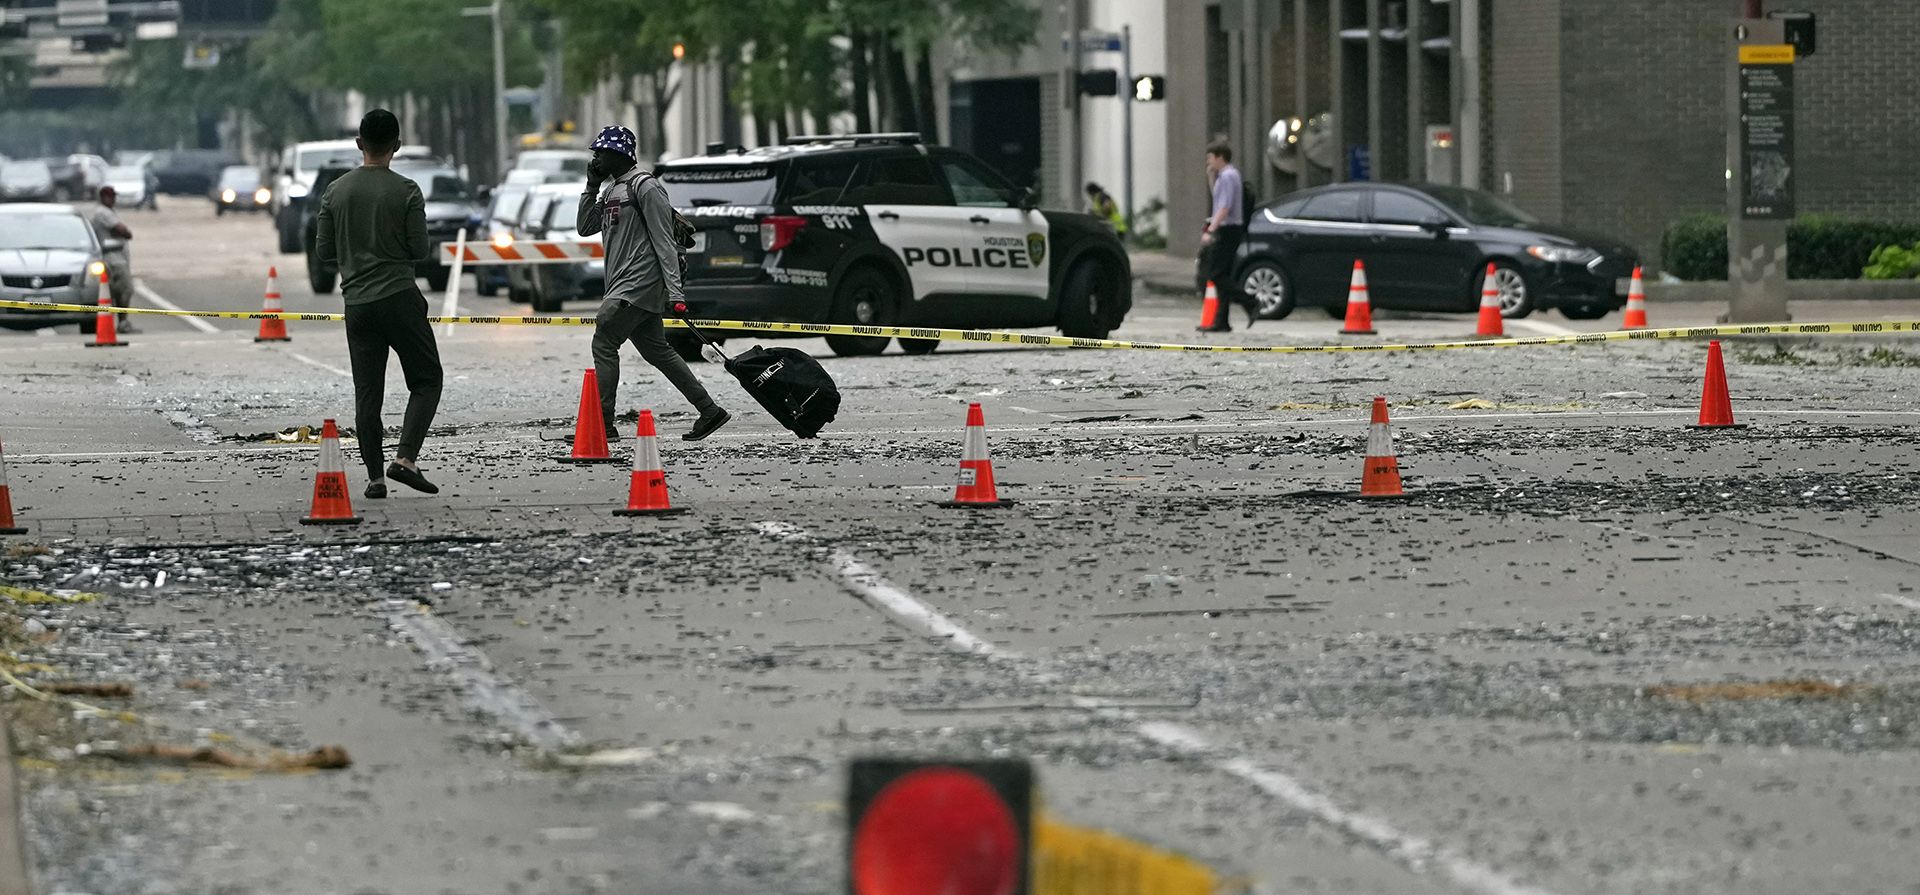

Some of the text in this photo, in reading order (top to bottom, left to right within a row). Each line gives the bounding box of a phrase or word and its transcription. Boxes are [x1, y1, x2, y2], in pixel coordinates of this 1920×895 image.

[695, 206, 757, 219] POLICE
[792, 206, 860, 215] EMERGENCY
[821, 215, 852, 229] 911
[983, 236, 1023, 247] HOUSTON
[902, 247, 1029, 268] POLICE
[852, 326, 882, 335] CAUTION
[1740, 326, 1770, 334] CAUTION
[1800, 324, 1830, 333] CUIDADO
[1852, 323, 1882, 331] CAUTION
[910, 328, 940, 338] CUIDADO
[962, 331, 992, 341] CAUTION
[1629, 331, 1658, 340] CAUTION
[1688, 327, 1718, 337] CUIDADO
[1020, 334, 1050, 344] CUIDADO
[1576, 333, 1606, 342] CUIDADO
[1072, 338, 1102, 347] CAUTION
